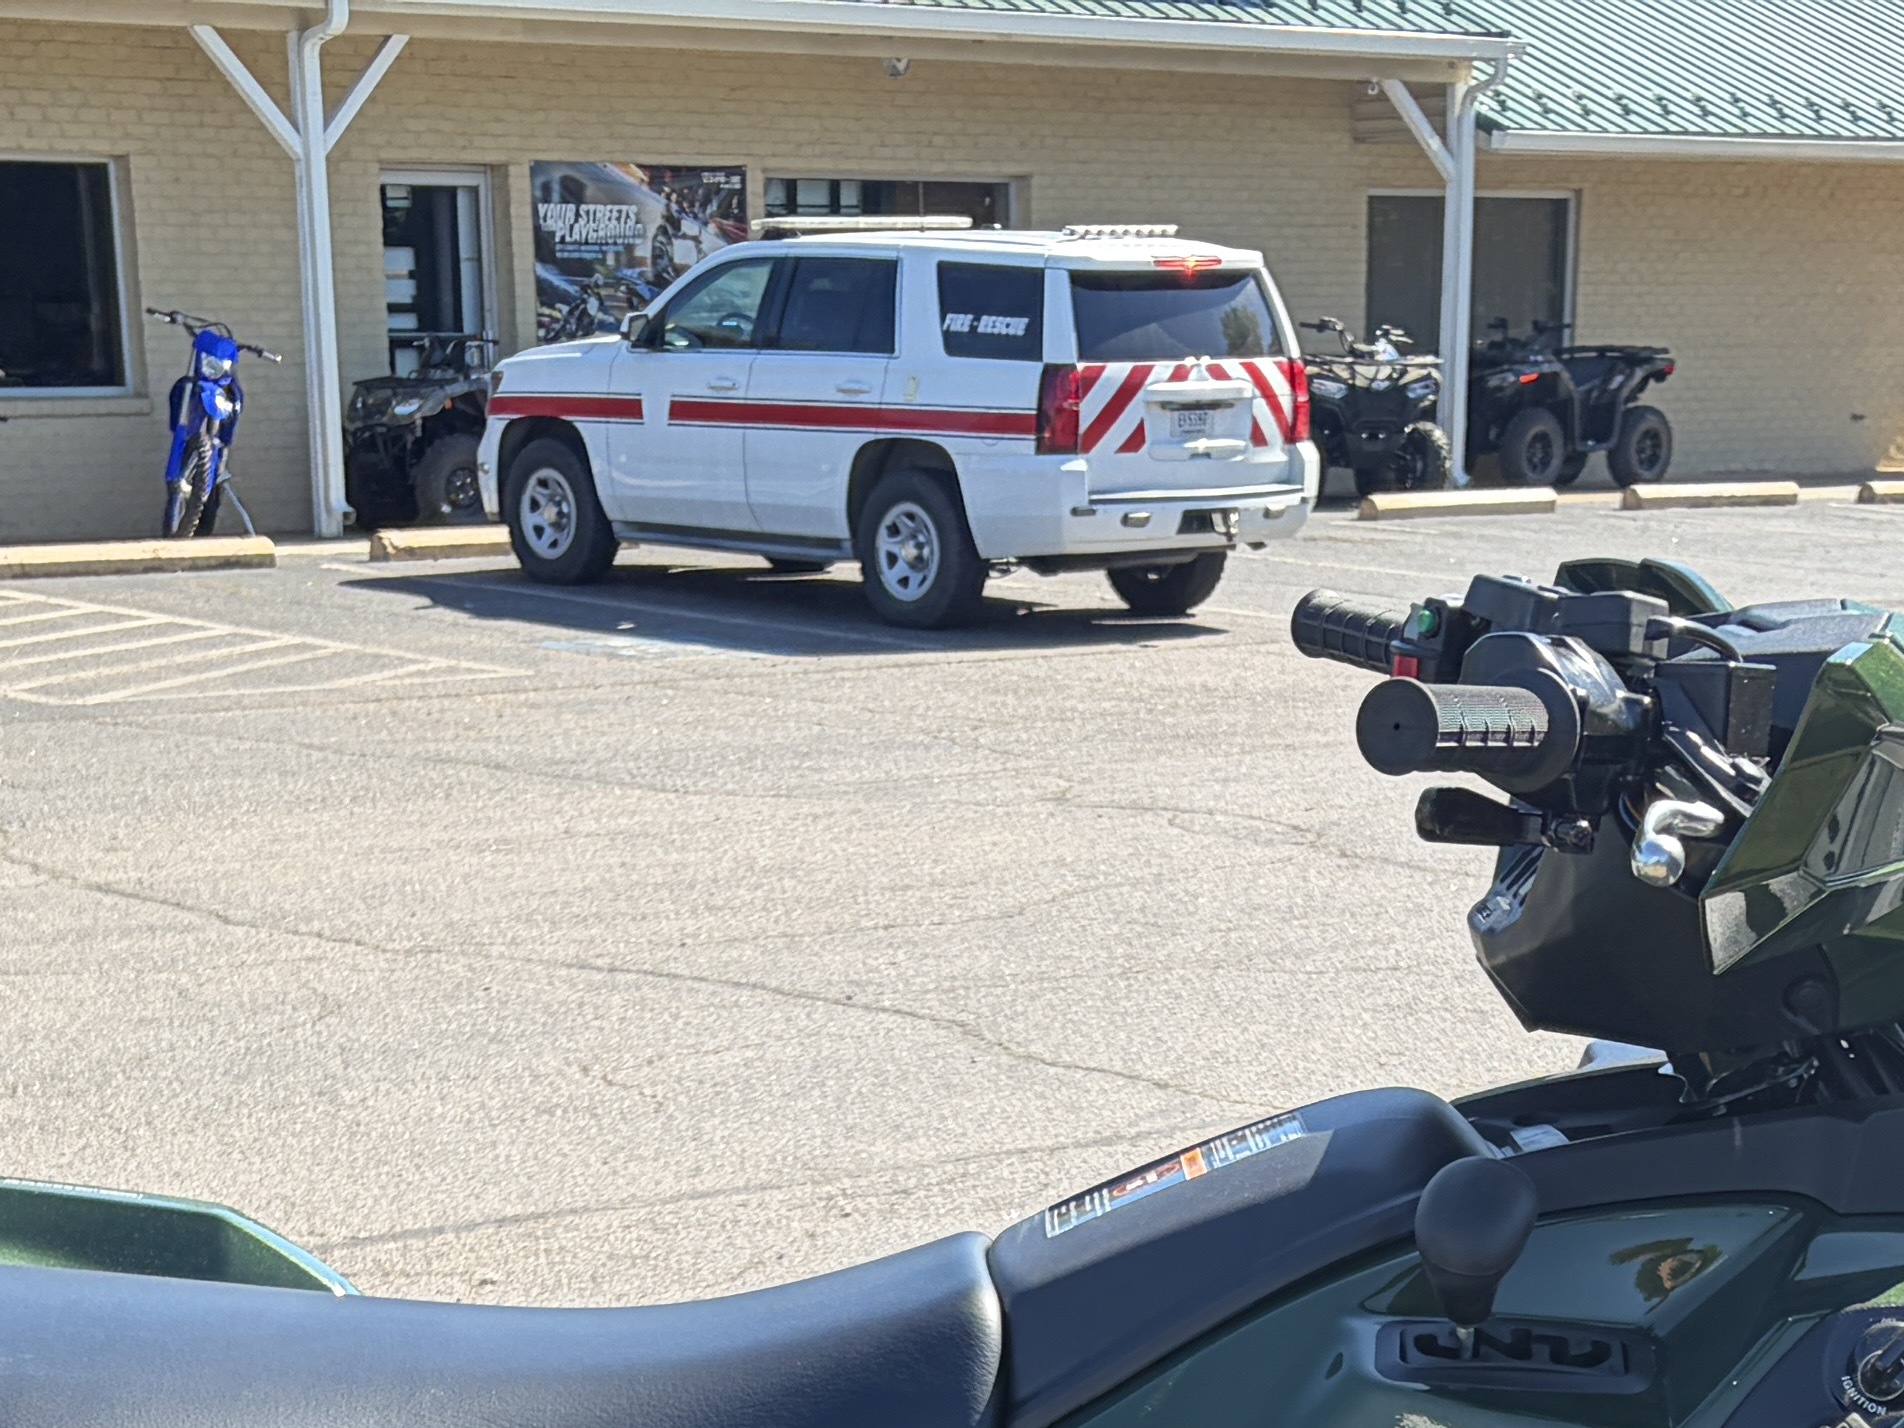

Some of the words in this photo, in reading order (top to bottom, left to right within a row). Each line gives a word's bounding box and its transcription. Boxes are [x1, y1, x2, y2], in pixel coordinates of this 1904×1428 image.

[538, 203, 575, 225] YOUR
[579, 204, 638, 225] STREETS
[555, 224, 644, 244] PLAYGROUND
[943, 313, 974, 332] FIRE
[977, 315, 1029, 336] RESCUE
[1841, 1375, 1887, 1416] IGNITION
